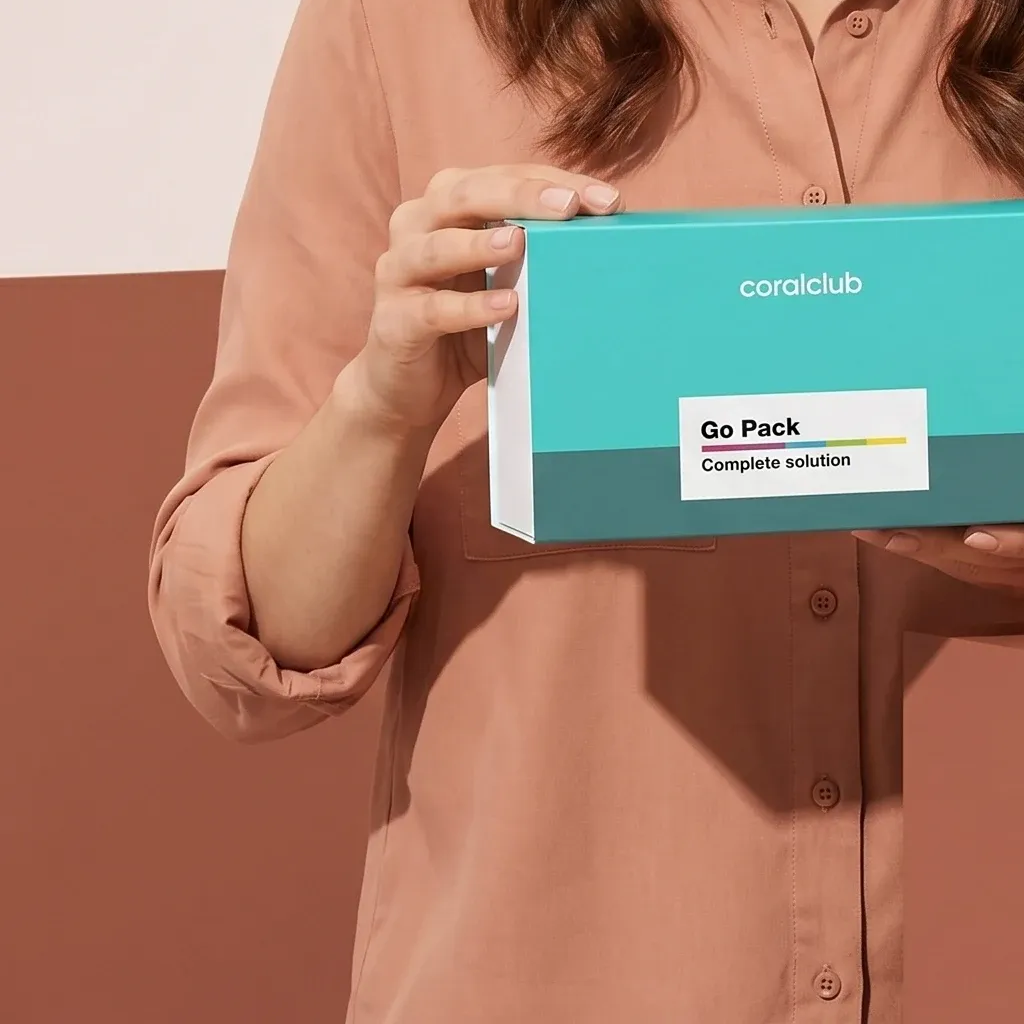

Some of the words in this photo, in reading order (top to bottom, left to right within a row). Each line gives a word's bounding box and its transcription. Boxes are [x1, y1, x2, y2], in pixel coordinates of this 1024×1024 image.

[739, 271, 863, 298] coralclub
[701, 420, 734, 439] Go
[741, 417, 801, 438] Pack
[701, 456, 781, 473] Complete
[785, 453, 851, 469] solution
